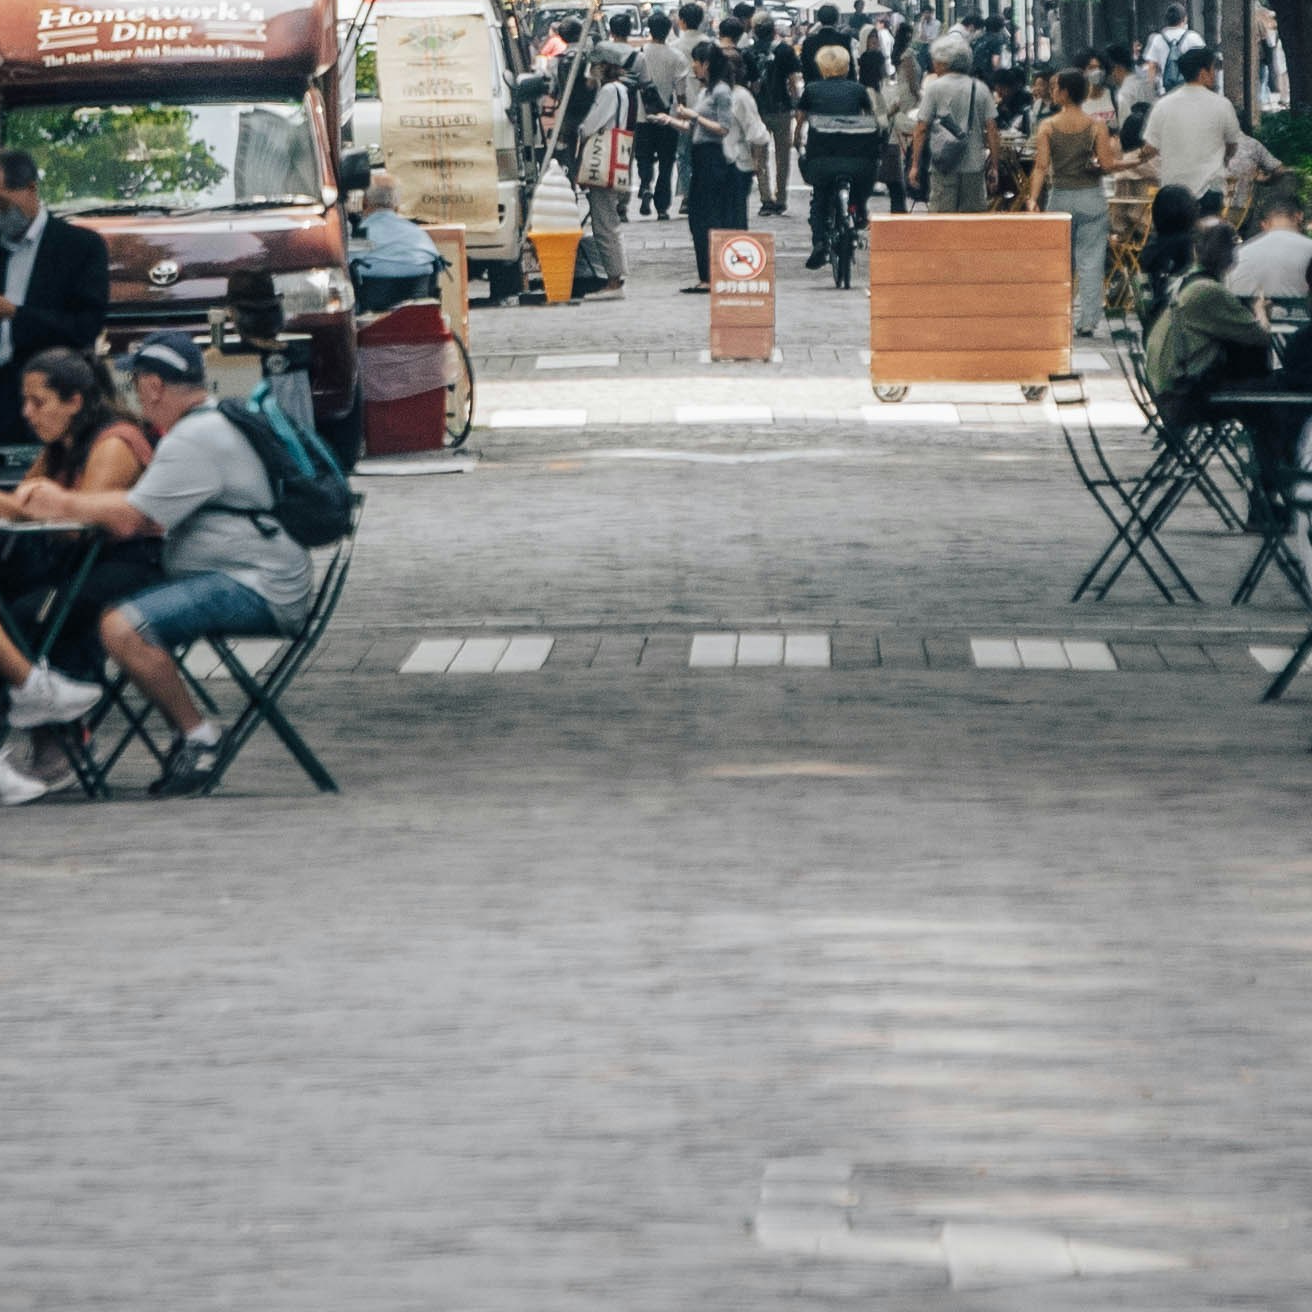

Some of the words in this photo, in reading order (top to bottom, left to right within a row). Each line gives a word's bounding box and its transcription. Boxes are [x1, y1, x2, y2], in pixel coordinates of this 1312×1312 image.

[37, 1, 265, 29] Homework's
[110, 22, 194, 43] Diner
[42, 54, 63, 68] The
[65, 52, 92, 65] Best
[94, 48, 134, 63] Burger
[134, 44, 162, 57] And
